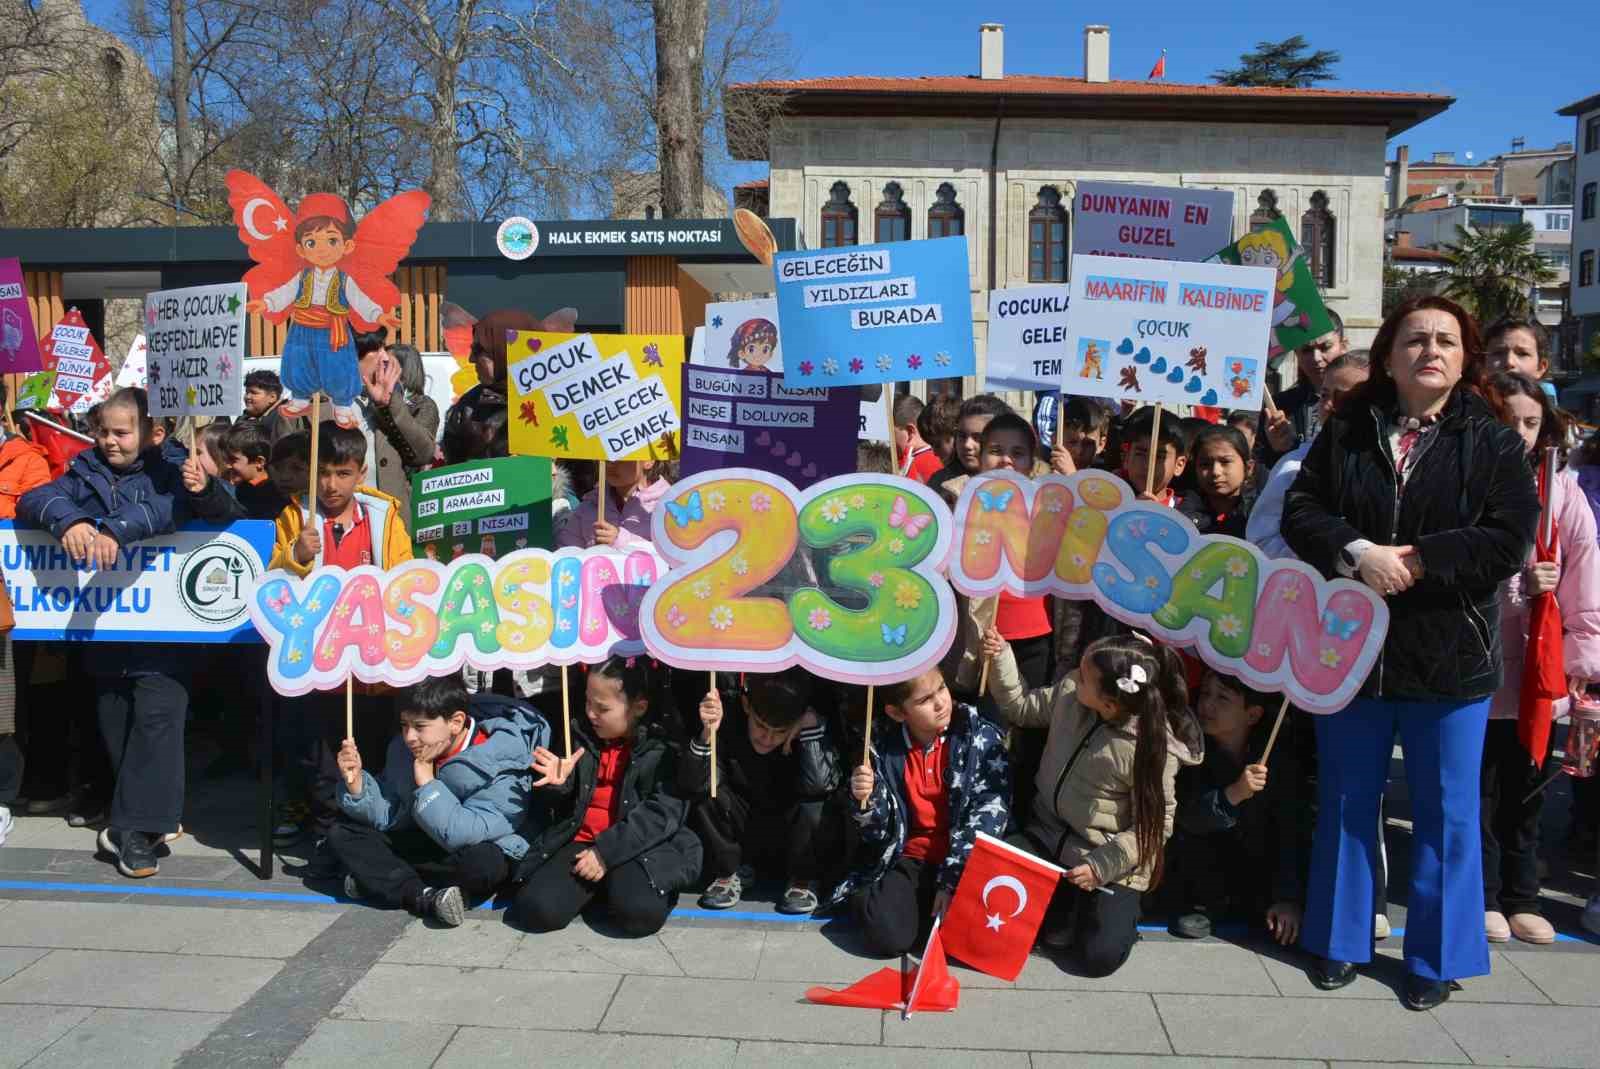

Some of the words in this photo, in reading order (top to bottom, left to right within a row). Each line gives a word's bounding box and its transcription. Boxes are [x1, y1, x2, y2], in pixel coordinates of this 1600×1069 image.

[1081, 193, 1170, 219] DUNYANIN
[1183, 204, 1209, 225] EN
[549, 232, 581, 244] HALK
[585, 231, 625, 243] EKMEK
[631, 231, 665, 245] SATIŞ
[668, 230, 721, 242] NOKTASI
[1118, 225, 1176, 247] GUZEL
[783, 254, 884, 276] GELECEĞİN
[810, 283, 908, 302] YILDIZLARI
[1182, 287, 1265, 312] KALBİNDE
[158, 301, 180, 320] HER
[183, 294, 225, 321] ÇOCUK
[859, 307, 937, 326] BURADA
[1137, 319, 1191, 338] ÇOCUK
[149, 324, 238, 356] KEŞFEDİLMEYE
[171, 357, 208, 378] HAZIR
[518, 341, 592, 392] ÇOCUK
[1033, 359, 1062, 376] TEM
[160, 382, 179, 409] BİR
[551, 362, 631, 411] DEMEK
[695, 378, 742, 393] BUGÜN
[747, 384, 765, 395] 23
[583, 382, 663, 431] GELECEK
[690, 403, 727, 419] NEŞE
[742, 409, 809, 423] DOLUYOR
[608, 411, 673, 453] DEMEK
[424, 472, 490, 490] ATAMIZDAN
